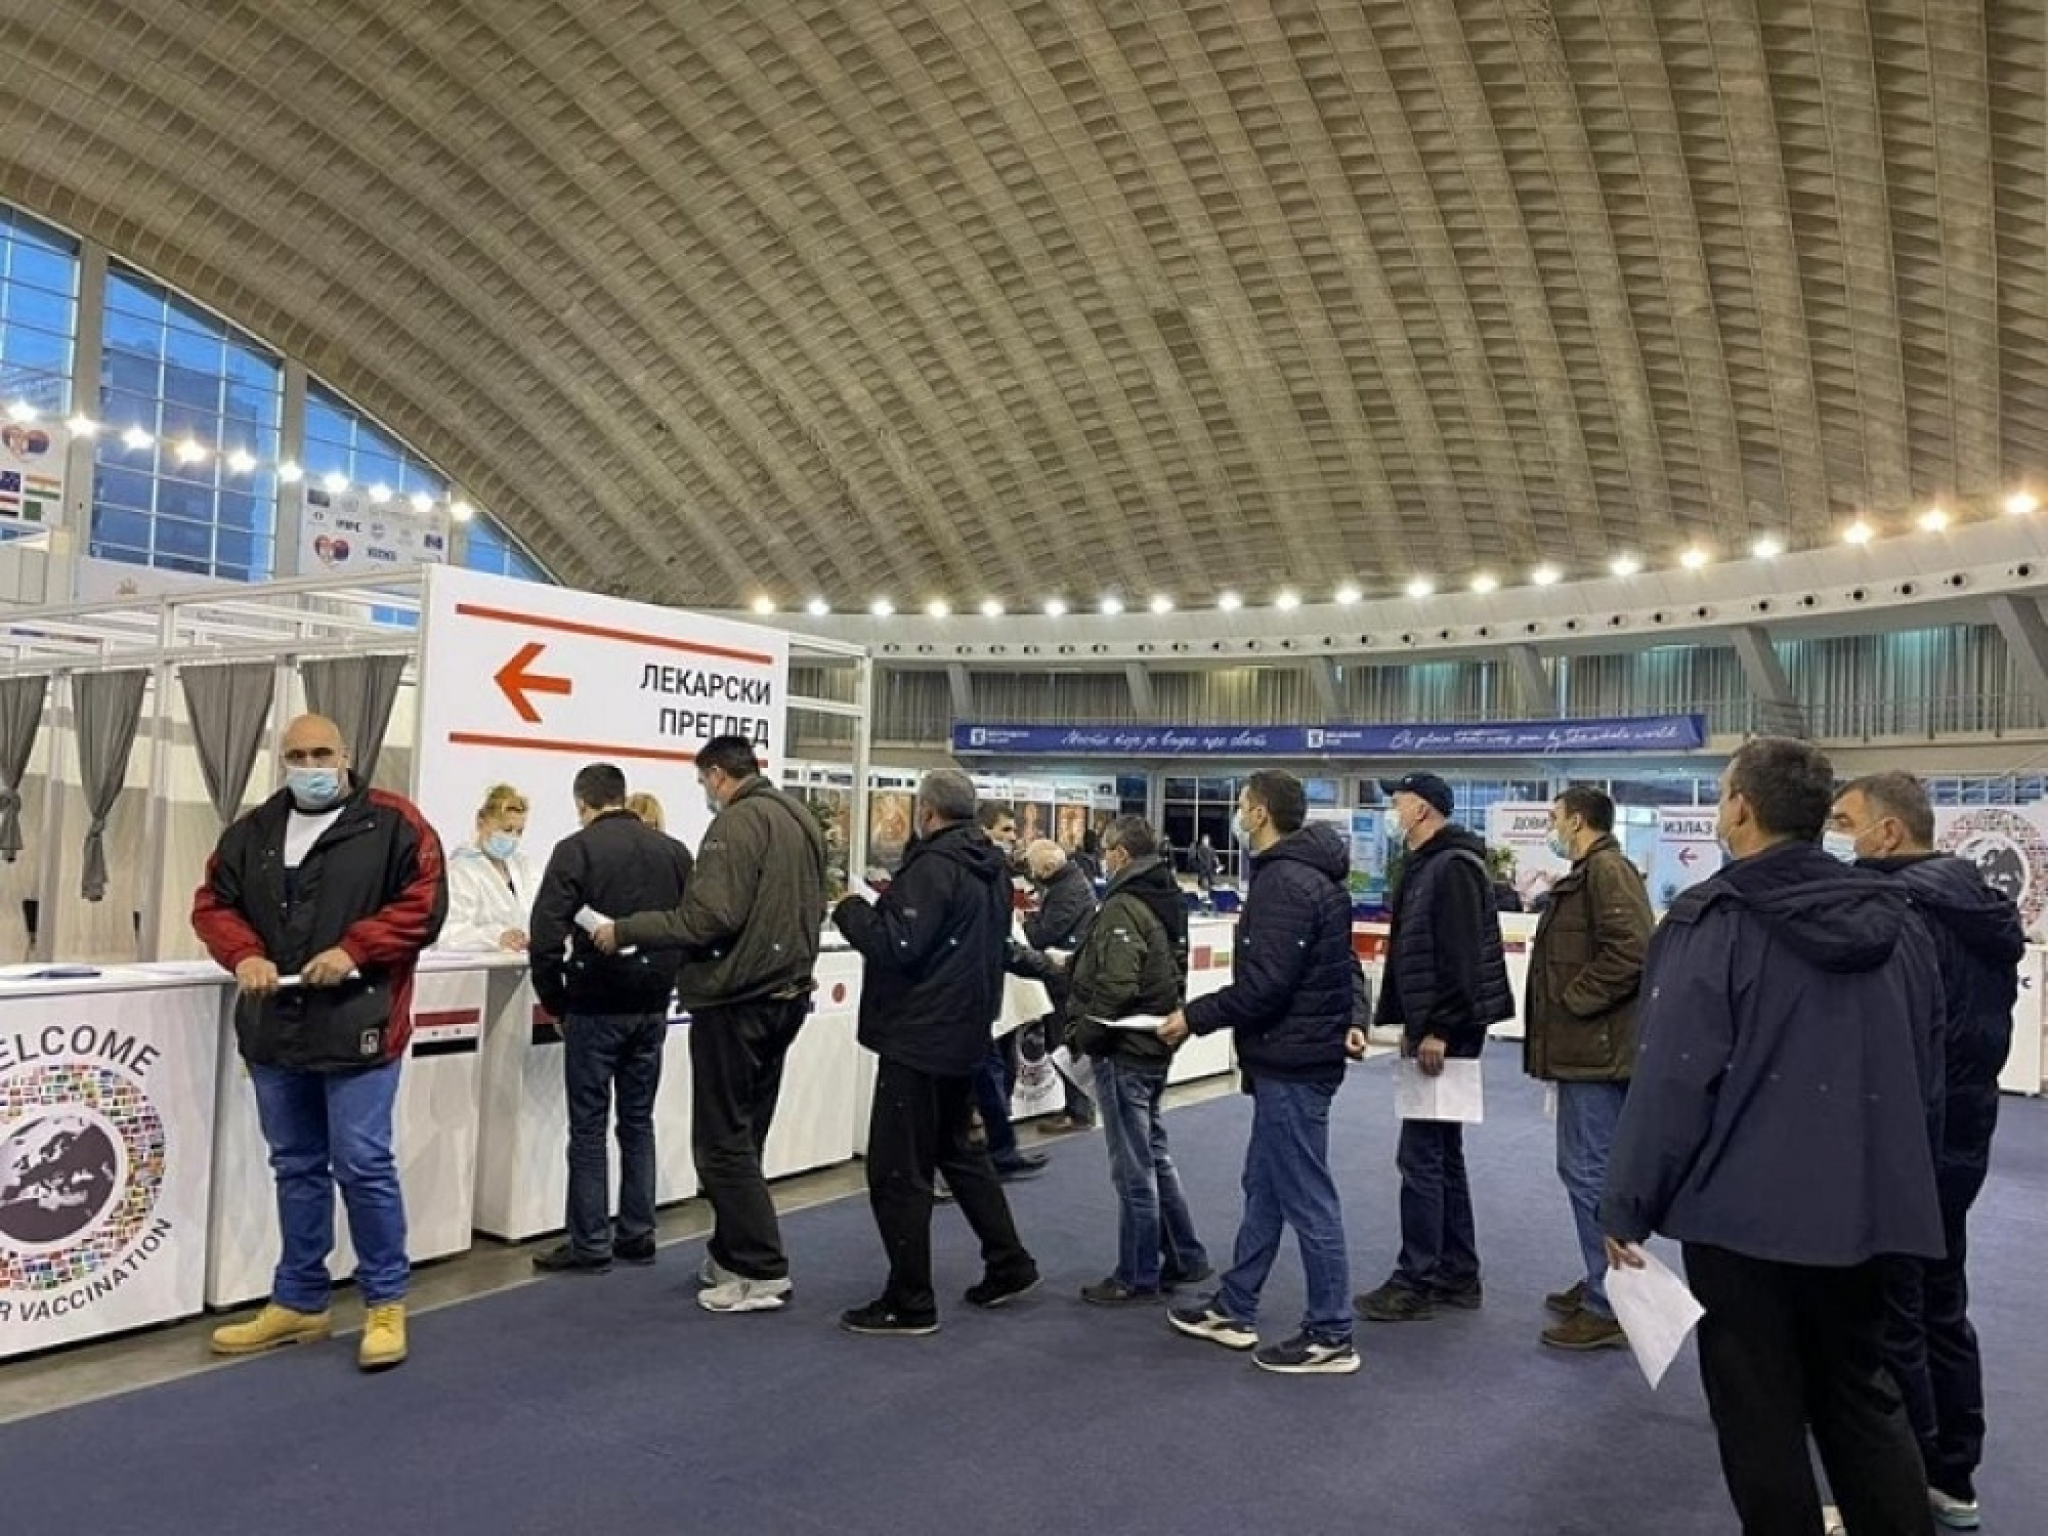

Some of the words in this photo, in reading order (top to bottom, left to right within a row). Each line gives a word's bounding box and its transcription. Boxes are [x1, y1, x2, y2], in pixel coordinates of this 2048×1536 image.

[639, 663, 771, 706] ЛЕКАРСКИ
[1663, 820, 1713, 836] ИЗЛАЗ
[20, 1217, 173, 1322] VACCINATION
